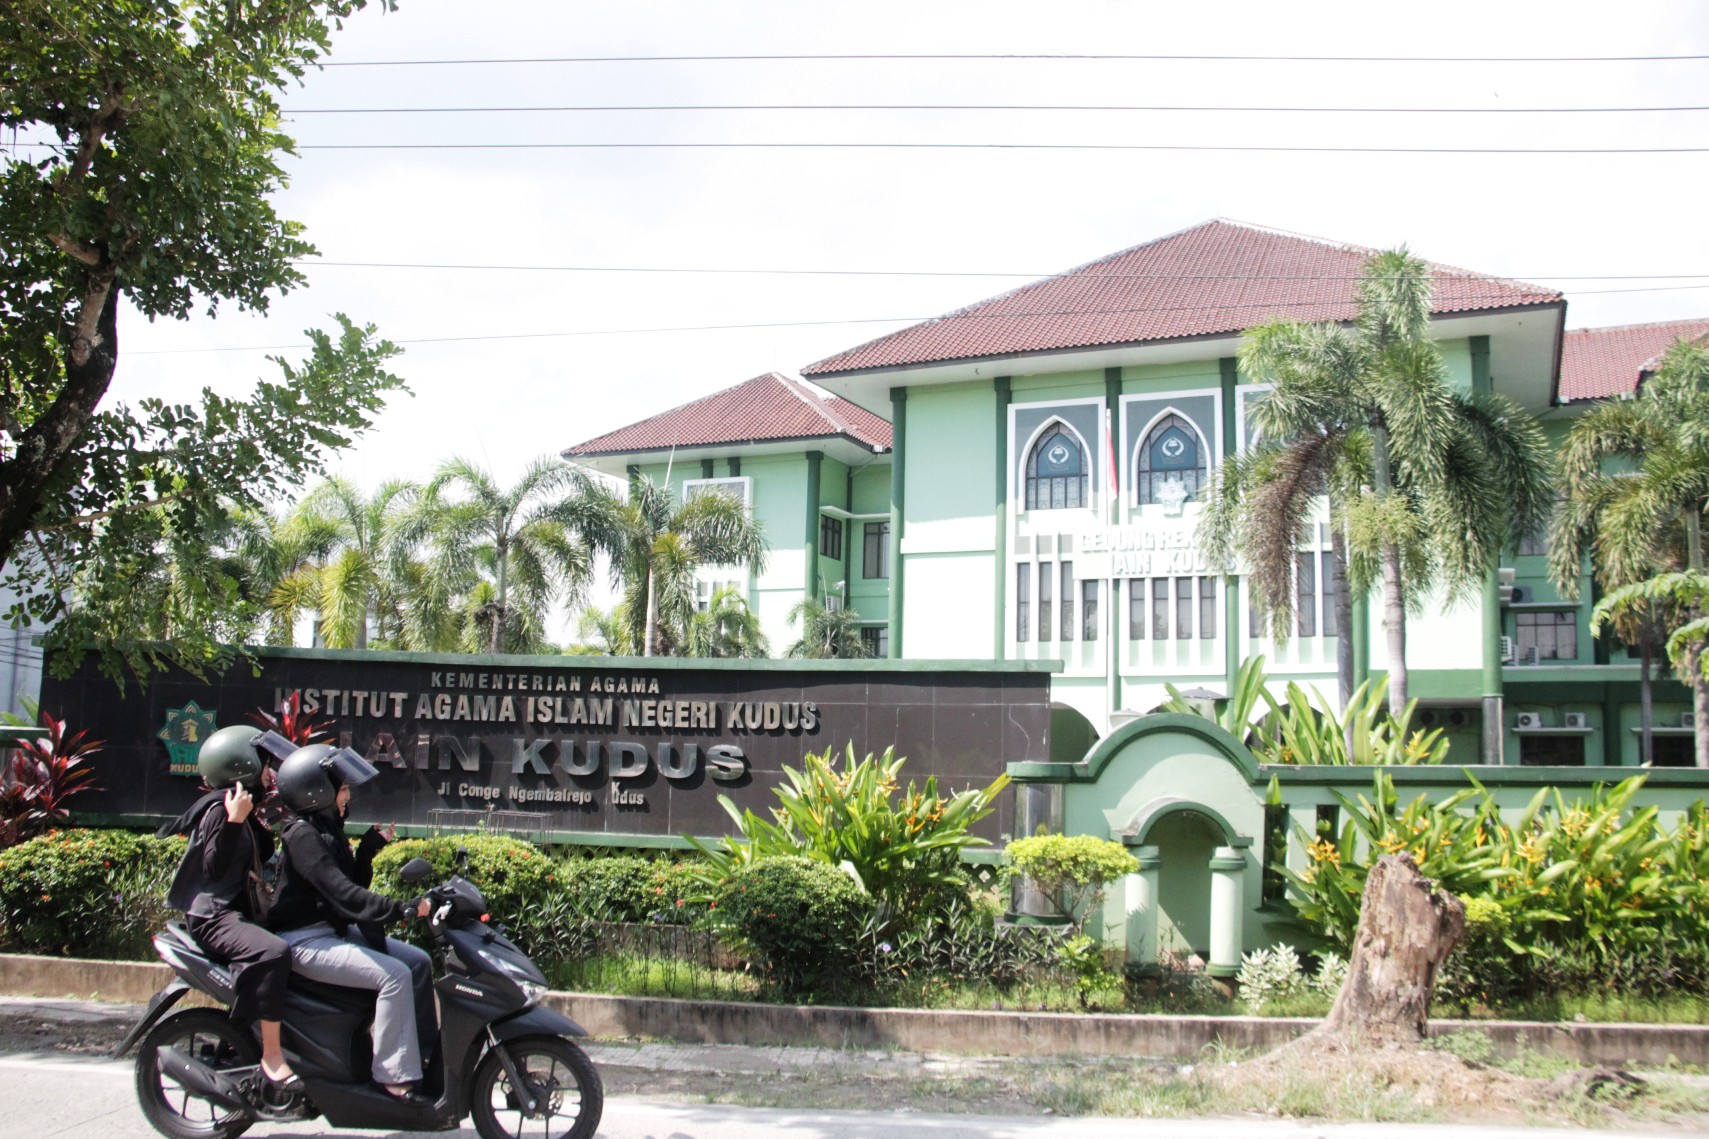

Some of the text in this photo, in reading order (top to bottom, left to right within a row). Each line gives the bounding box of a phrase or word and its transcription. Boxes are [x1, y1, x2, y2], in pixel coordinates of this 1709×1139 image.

[431, 671, 660, 694] KEMENTERIAN AGAMA
[414, 692, 517, 722] AGAMA
[526, 695, 613, 726] ISLAM
[622, 698, 717, 729] NEGERI
[727, 700, 818, 731] KUDUS
[169, 763, 200, 773] KUDU
[511, 737, 745, 781] KUDUS
[458, 783, 500, 800] Conge
[508, 785, 592, 804] Ngembalrejo
[611, 781, 644, 805] Kudus
[455, 984, 483, 997] HONDA
